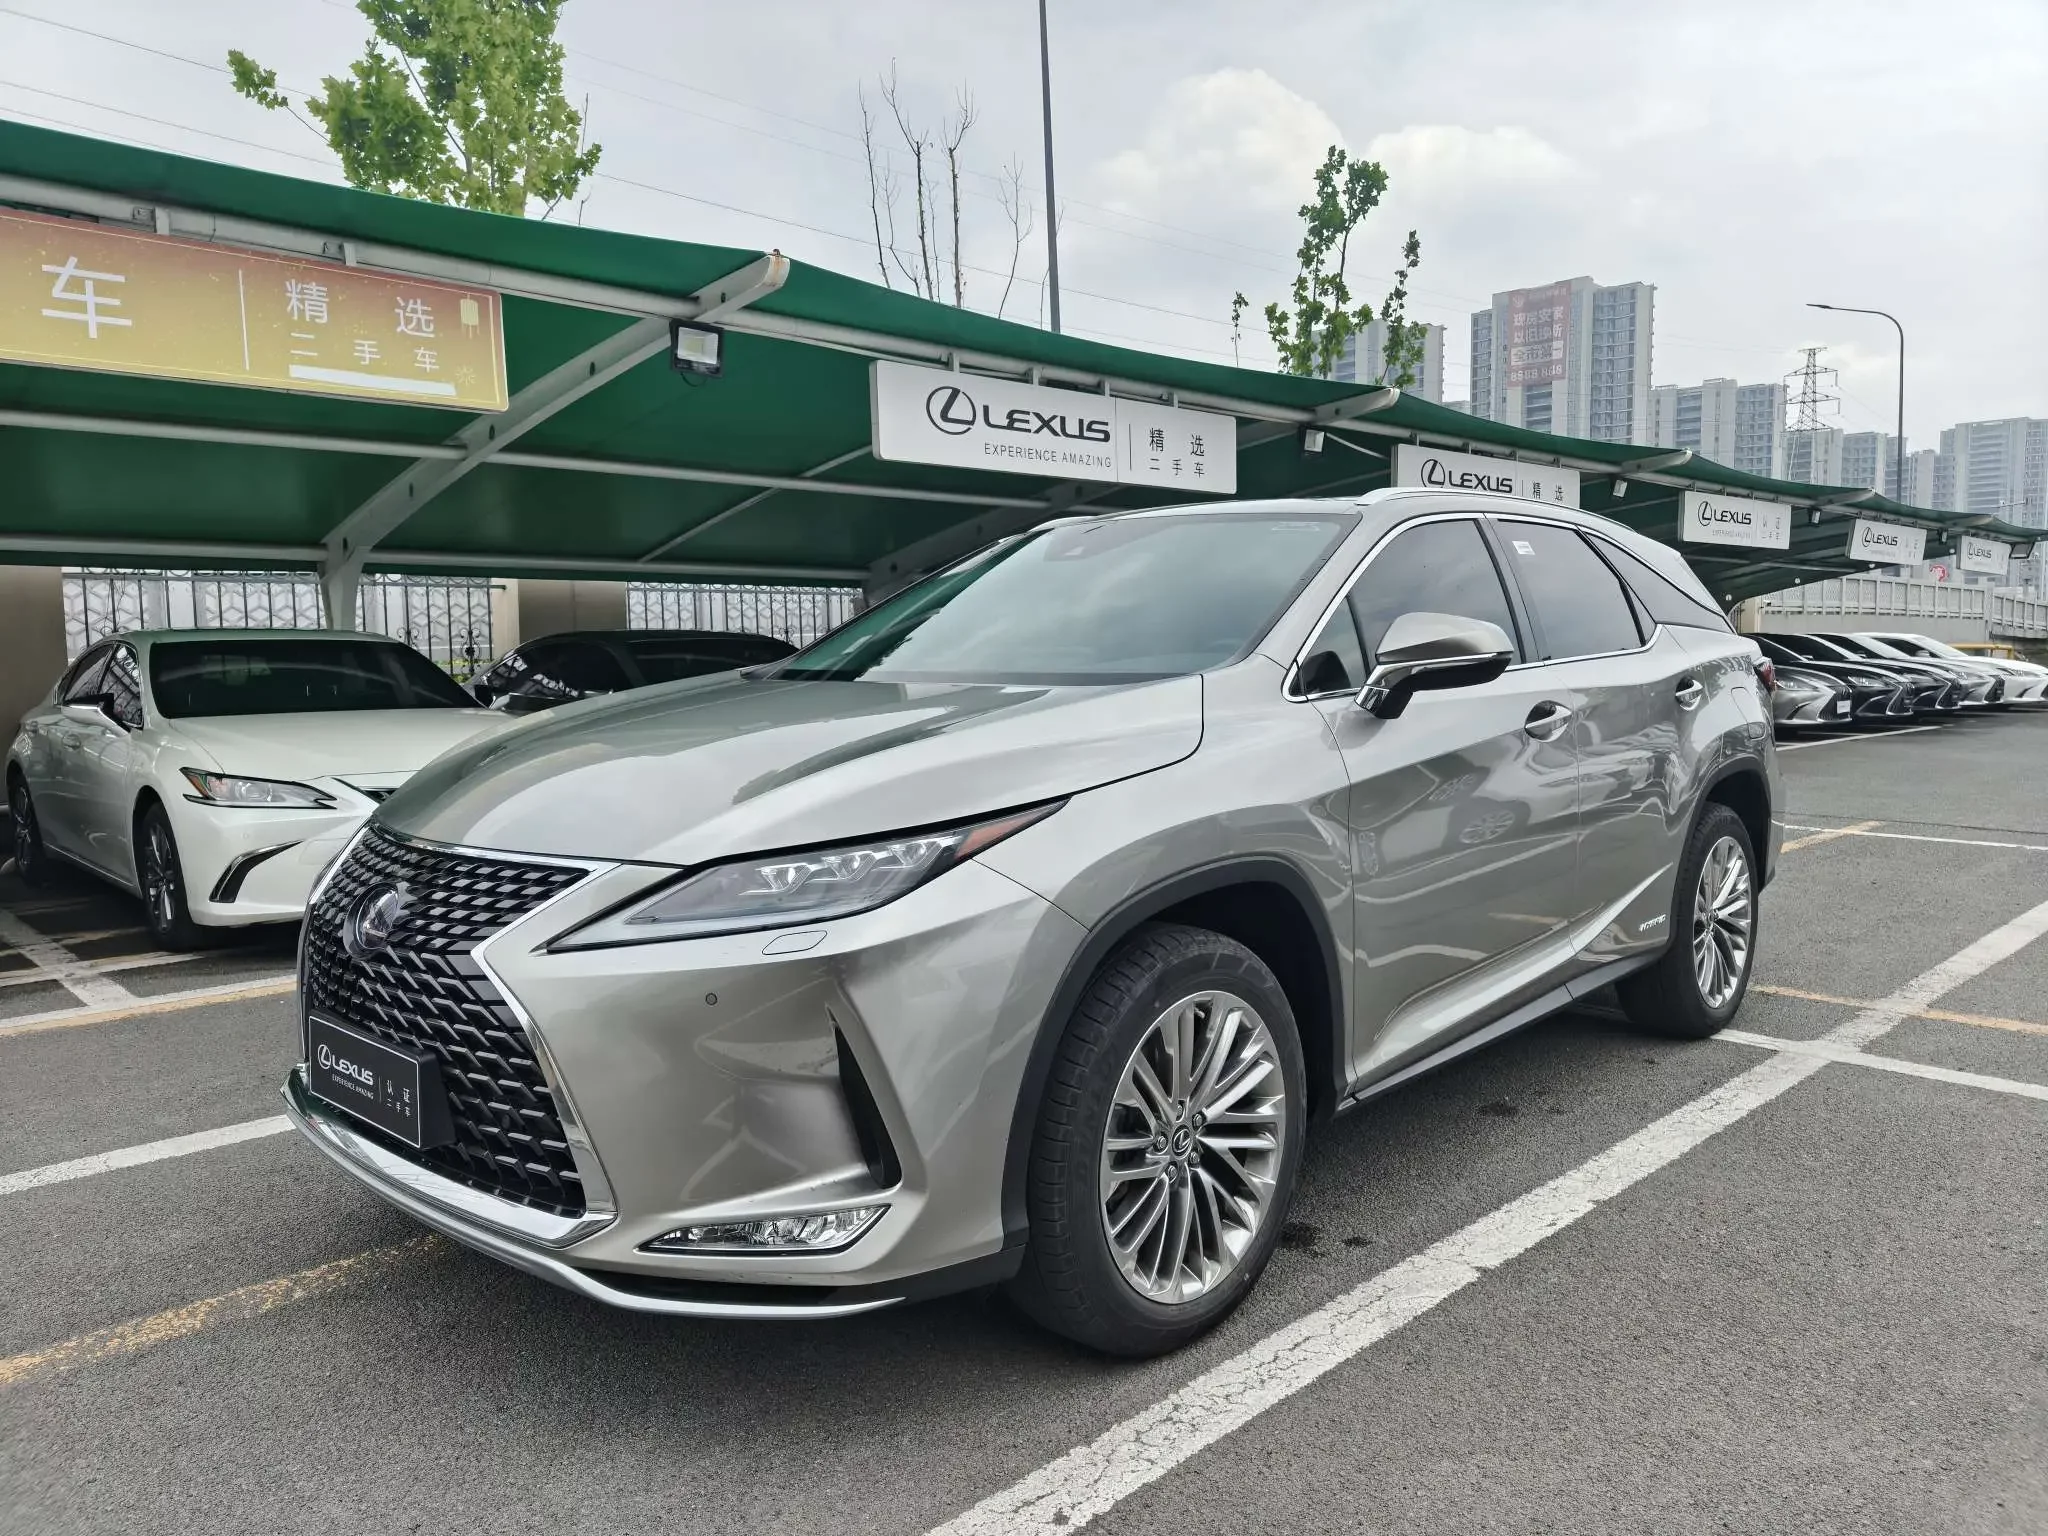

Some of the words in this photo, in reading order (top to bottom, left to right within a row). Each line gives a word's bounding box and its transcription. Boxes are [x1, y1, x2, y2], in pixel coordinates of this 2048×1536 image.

[41, 256, 133, 339] 车
[285, 278, 436, 338] 精选
[290, 331, 440, 373] 二手车
[982, 404, 1111, 443] LEXUS
[984, 442, 1059, 462] EXPERIENCE
[1062, 451, 1112, 468] AMAZING
[1149, 427, 1205, 457] 精选
[1149, 458, 1205, 477] 二手车
[1448, 470, 1513, 493] LEXUS
[1713, 509, 1752, 525] LEXUS
[1872, 533, 1898, 546] LEXUS
[1974, 547, 1992, 559] LEXUS
[332, 1055, 374, 1086] LEXUS
